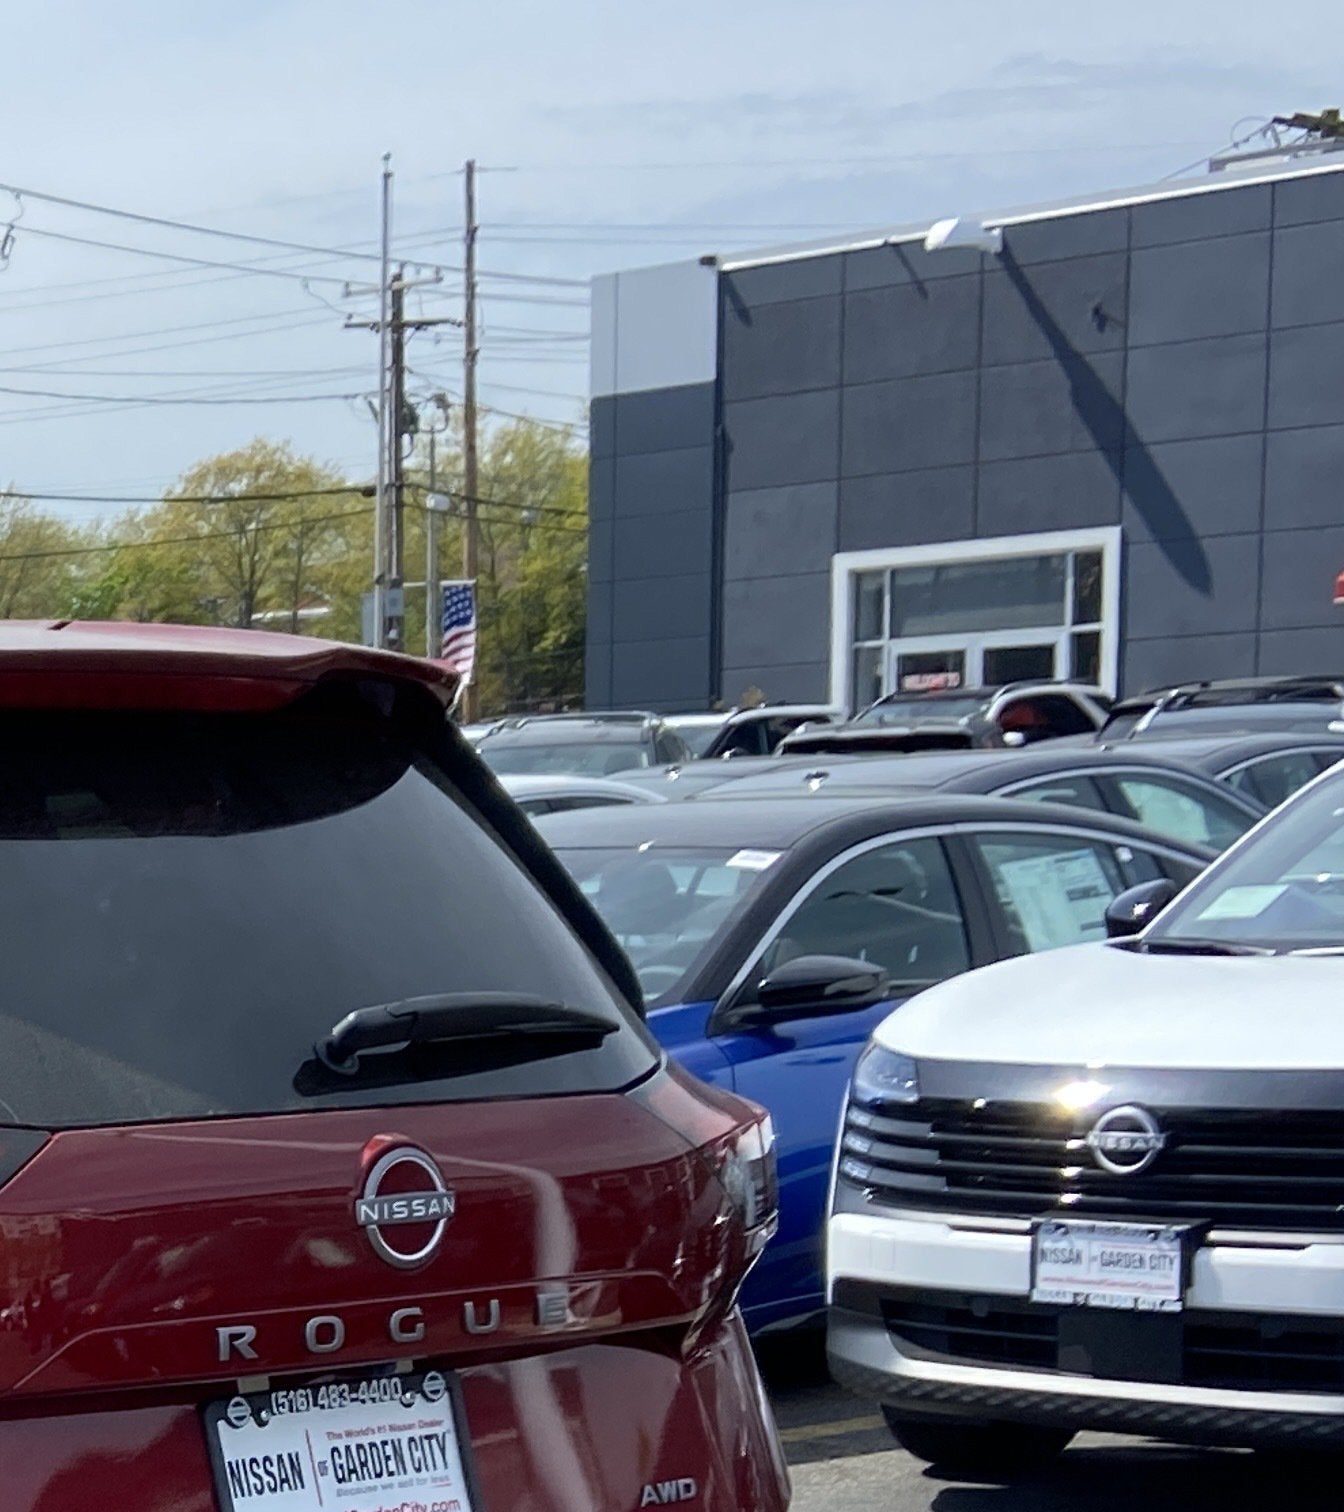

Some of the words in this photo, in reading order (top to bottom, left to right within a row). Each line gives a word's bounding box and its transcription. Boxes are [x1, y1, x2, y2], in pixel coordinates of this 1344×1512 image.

[1090, 1133, 1166, 1150] NISSAN
[360, 1197, 455, 1221] NISSAN
[215, 1292, 568, 1362] ROGUE
[227, 1451, 305, 1499] NISSAN
[330, 1437, 408, 1484] GARDEN
[408, 1431, 448, 1474] CITY
[640, 1477, 698, 1508] AWD
